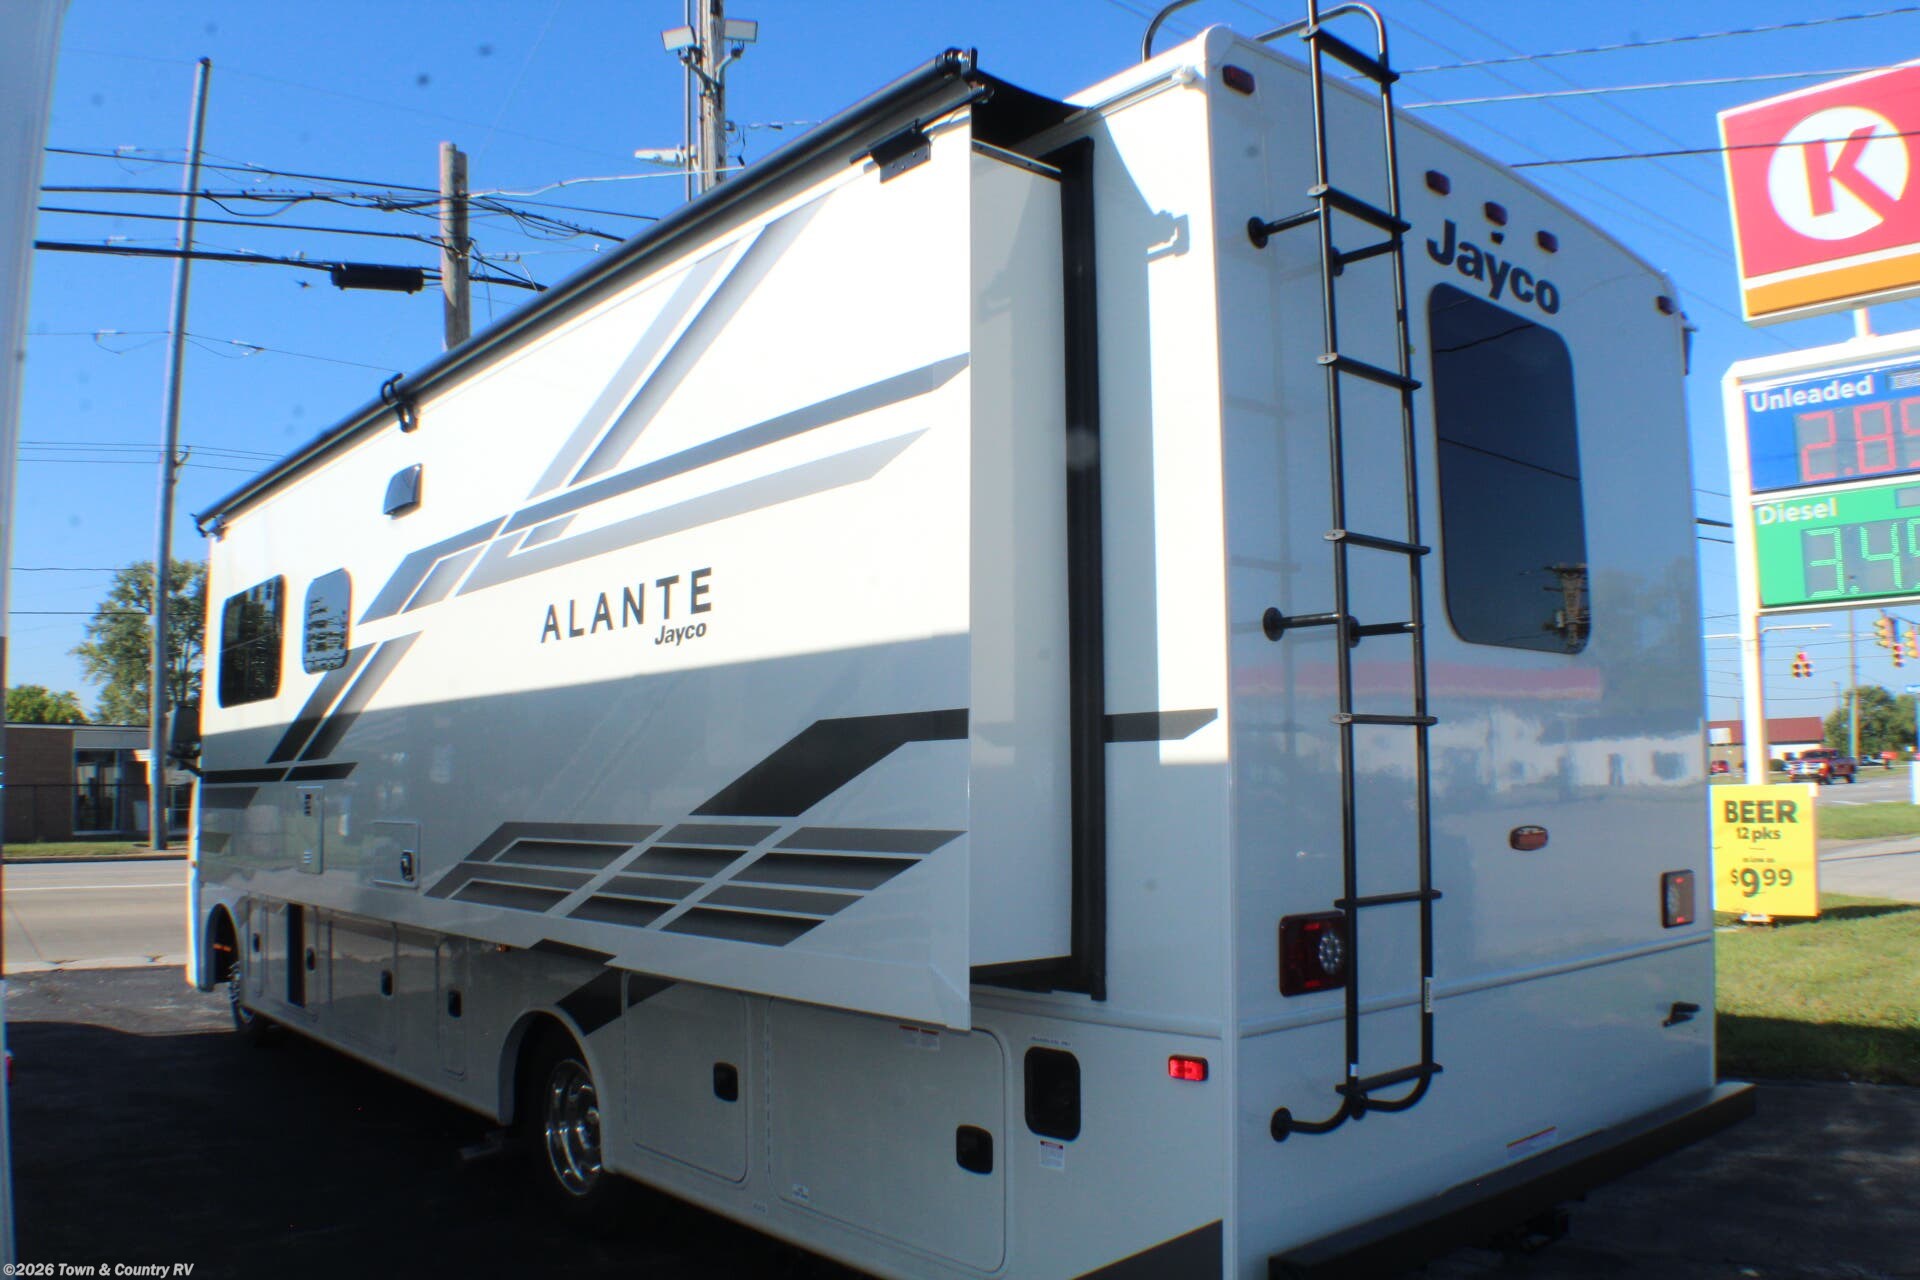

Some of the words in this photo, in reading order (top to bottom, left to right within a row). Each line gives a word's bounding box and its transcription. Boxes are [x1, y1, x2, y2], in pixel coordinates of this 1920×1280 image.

[1803, 123, 1900, 219] K
[1426, 219, 1561, 315] Jayco
[1750, 375, 1875, 413] Unleaded
[1758, 498, 1838, 526] Diesel
[540, 567, 712, 644] ALANTE
[654, 622, 707, 646] Jayco
[1724, 799, 1798, 824] BEER
[1736, 826, 1750, 840] 12
[1752, 826, 1782, 843] pks
